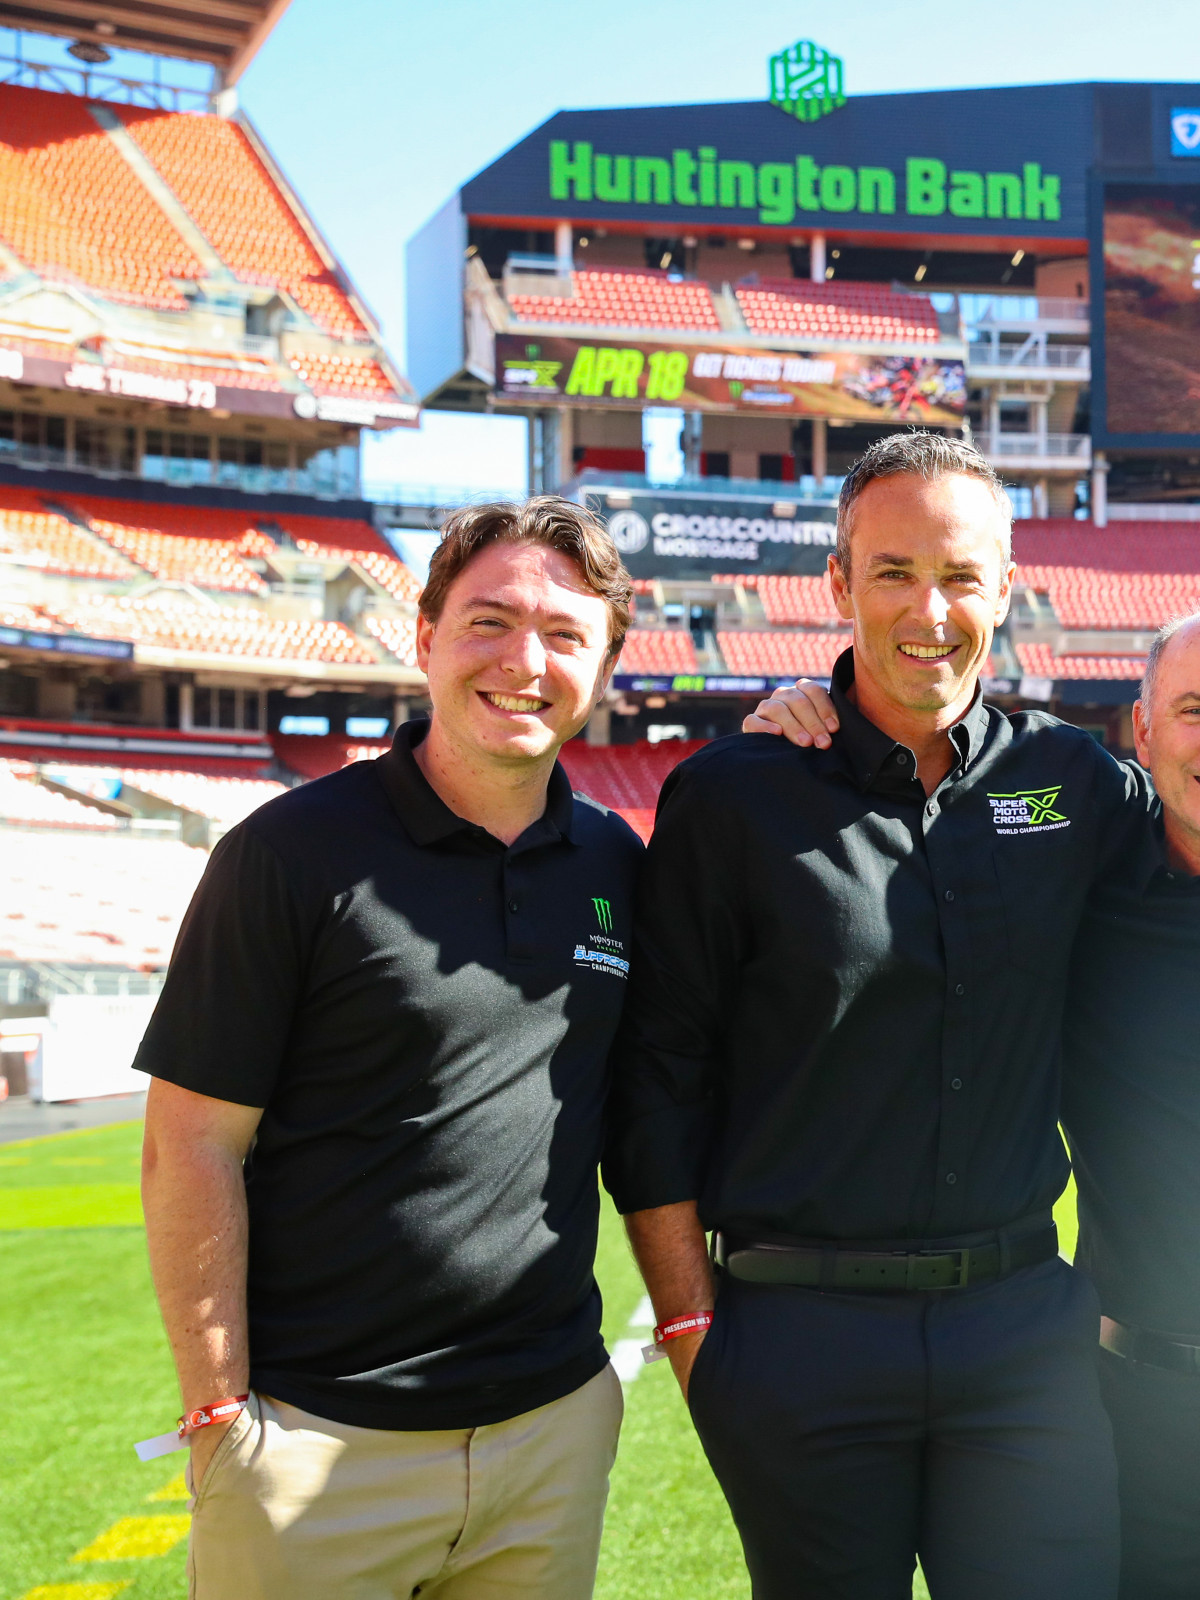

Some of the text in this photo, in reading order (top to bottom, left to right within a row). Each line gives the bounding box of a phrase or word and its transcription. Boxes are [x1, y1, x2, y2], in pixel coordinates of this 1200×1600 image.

[549, 140, 1061, 225] Huntington Bank
[565, 346, 644, 398] APR
[645, 350, 689, 401] 18
[651, 512, 838, 546] CROSSCOUNTRY
[653, 537, 759, 560] MORTGAGE
[989, 799, 1027, 807] SUPER
[993, 815, 1031, 824] CROSS
[994, 808, 1027, 816] MOTO
[1019, 820, 1072, 834] CHAMPIONSHIP
[589, 934, 624, 950] MONSTER
[664, 1319, 695, 1334] PRESEASON
[696, 1317, 705, 1325] WK
